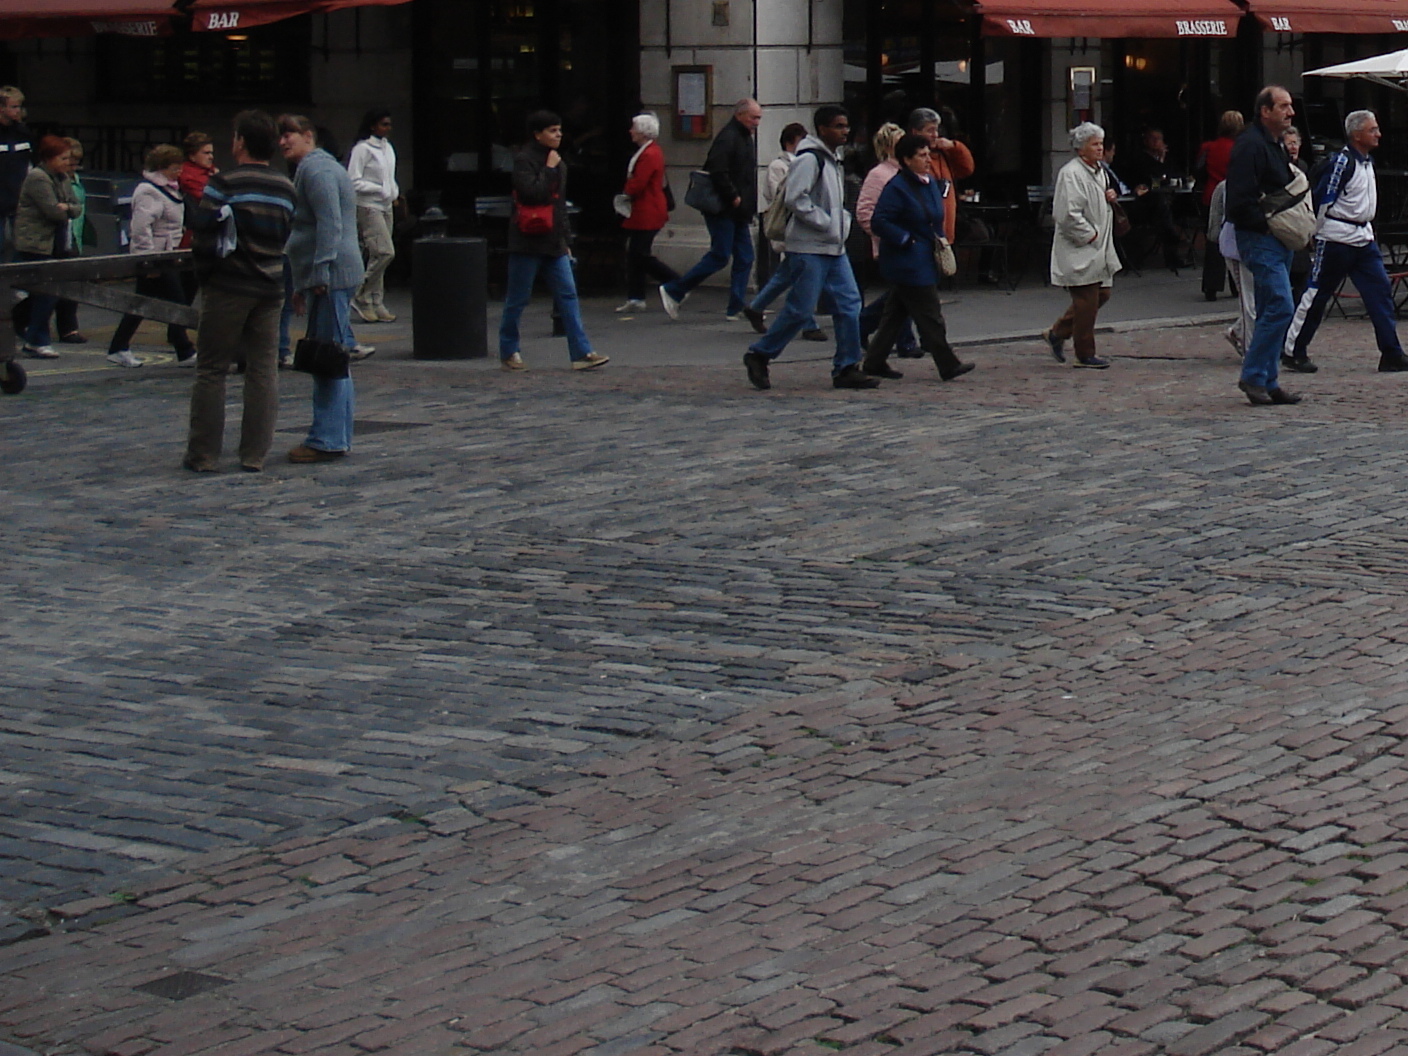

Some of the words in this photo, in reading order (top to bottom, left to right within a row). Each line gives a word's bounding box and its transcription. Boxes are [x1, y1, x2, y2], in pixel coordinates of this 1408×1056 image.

[208, 12, 239, 29] BAR
[1007, 19, 1035, 35] BAR
[1175, 20, 1228, 36] BRASSERIE
[1270, 17, 1292, 31] BAR
